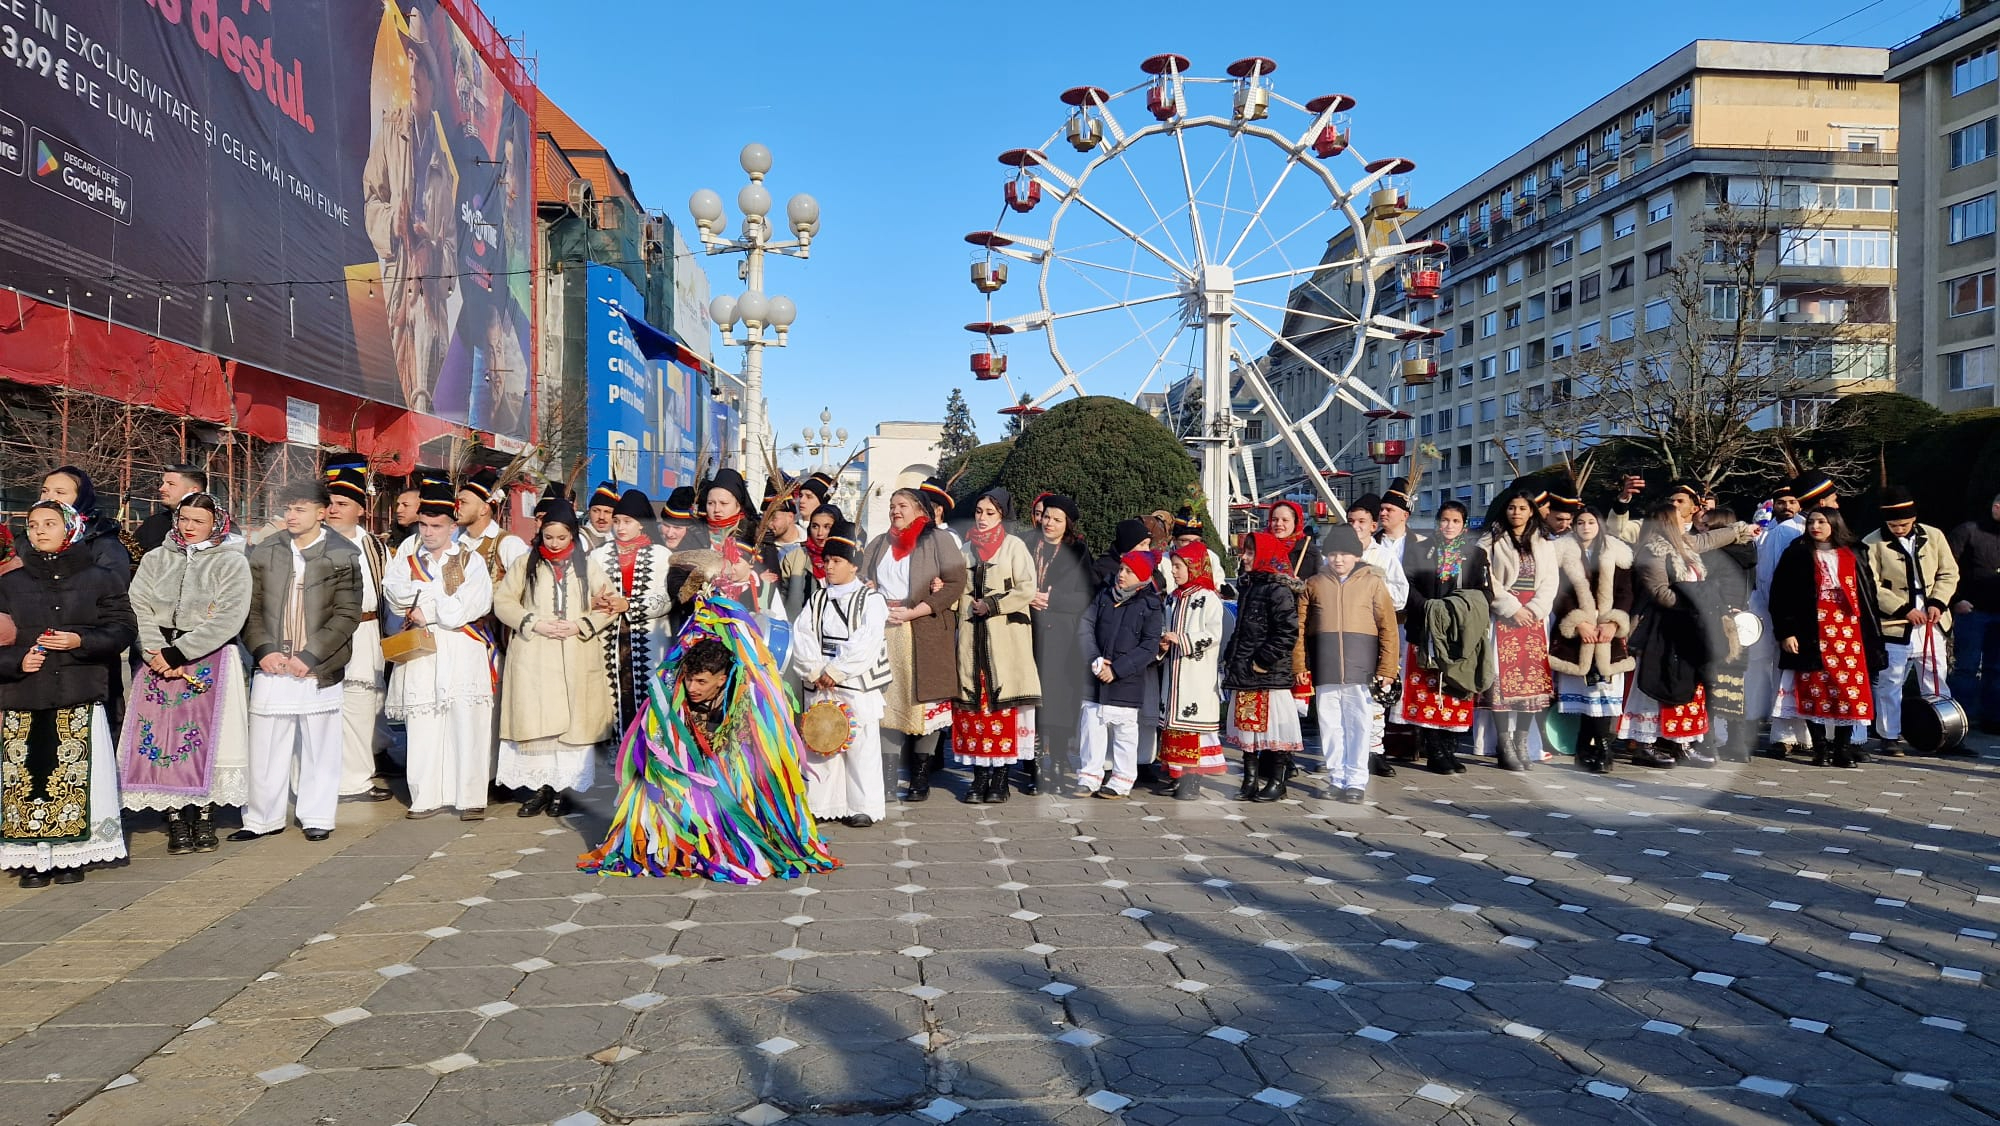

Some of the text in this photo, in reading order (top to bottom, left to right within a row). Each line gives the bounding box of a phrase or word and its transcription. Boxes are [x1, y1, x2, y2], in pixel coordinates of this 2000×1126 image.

[1, 24, 155, 142] 3,99 € PE LUNĂ
[65, 23, 200, 135] EXCLUSIVITATE
[204, 119, 217, 148] ȘI
[221, 132, 257, 172] CELE
[260, 157, 285, 188] MAI
[287, 174, 316, 206] TARI
[317, 194, 350, 227] FILME
[191, 0, 316, 134] destul.
[63, 166, 128, 216] Google Play
